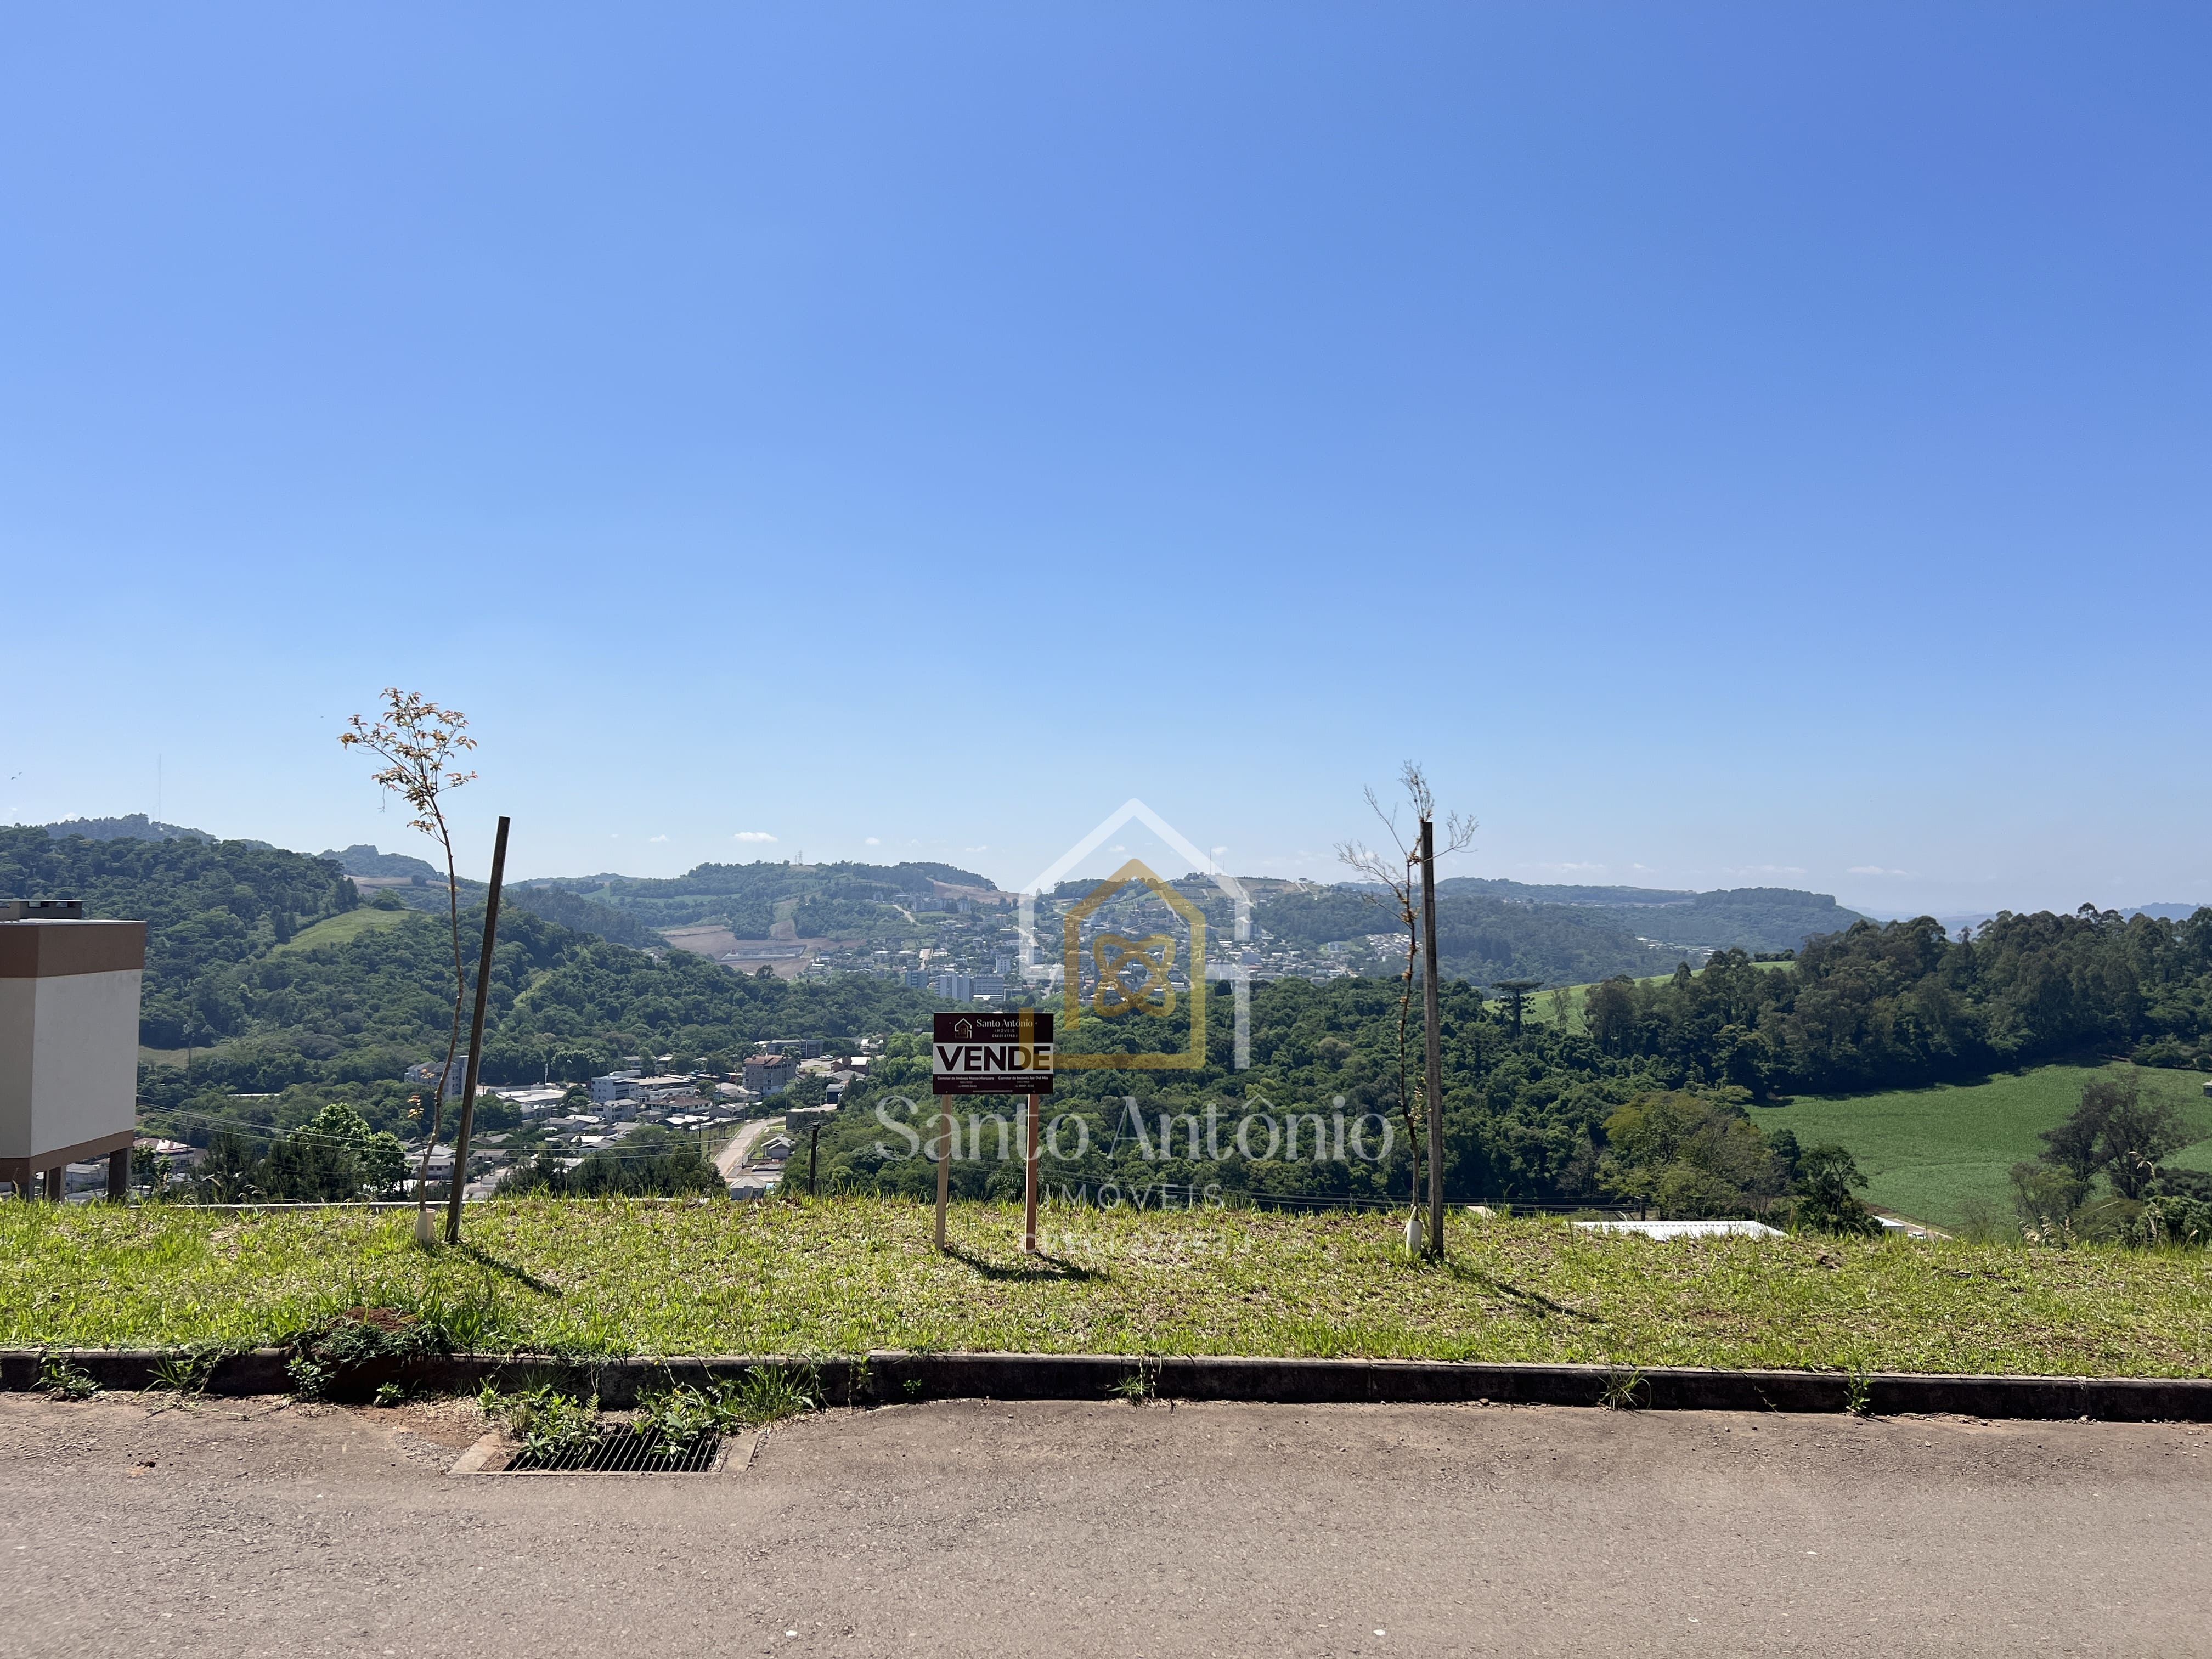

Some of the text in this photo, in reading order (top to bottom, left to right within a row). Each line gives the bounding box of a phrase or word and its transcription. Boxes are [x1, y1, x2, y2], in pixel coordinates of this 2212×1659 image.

[977, 1019, 1034, 1028] Santo Antônio
[936, 1046, 1051, 1071] VENDE
